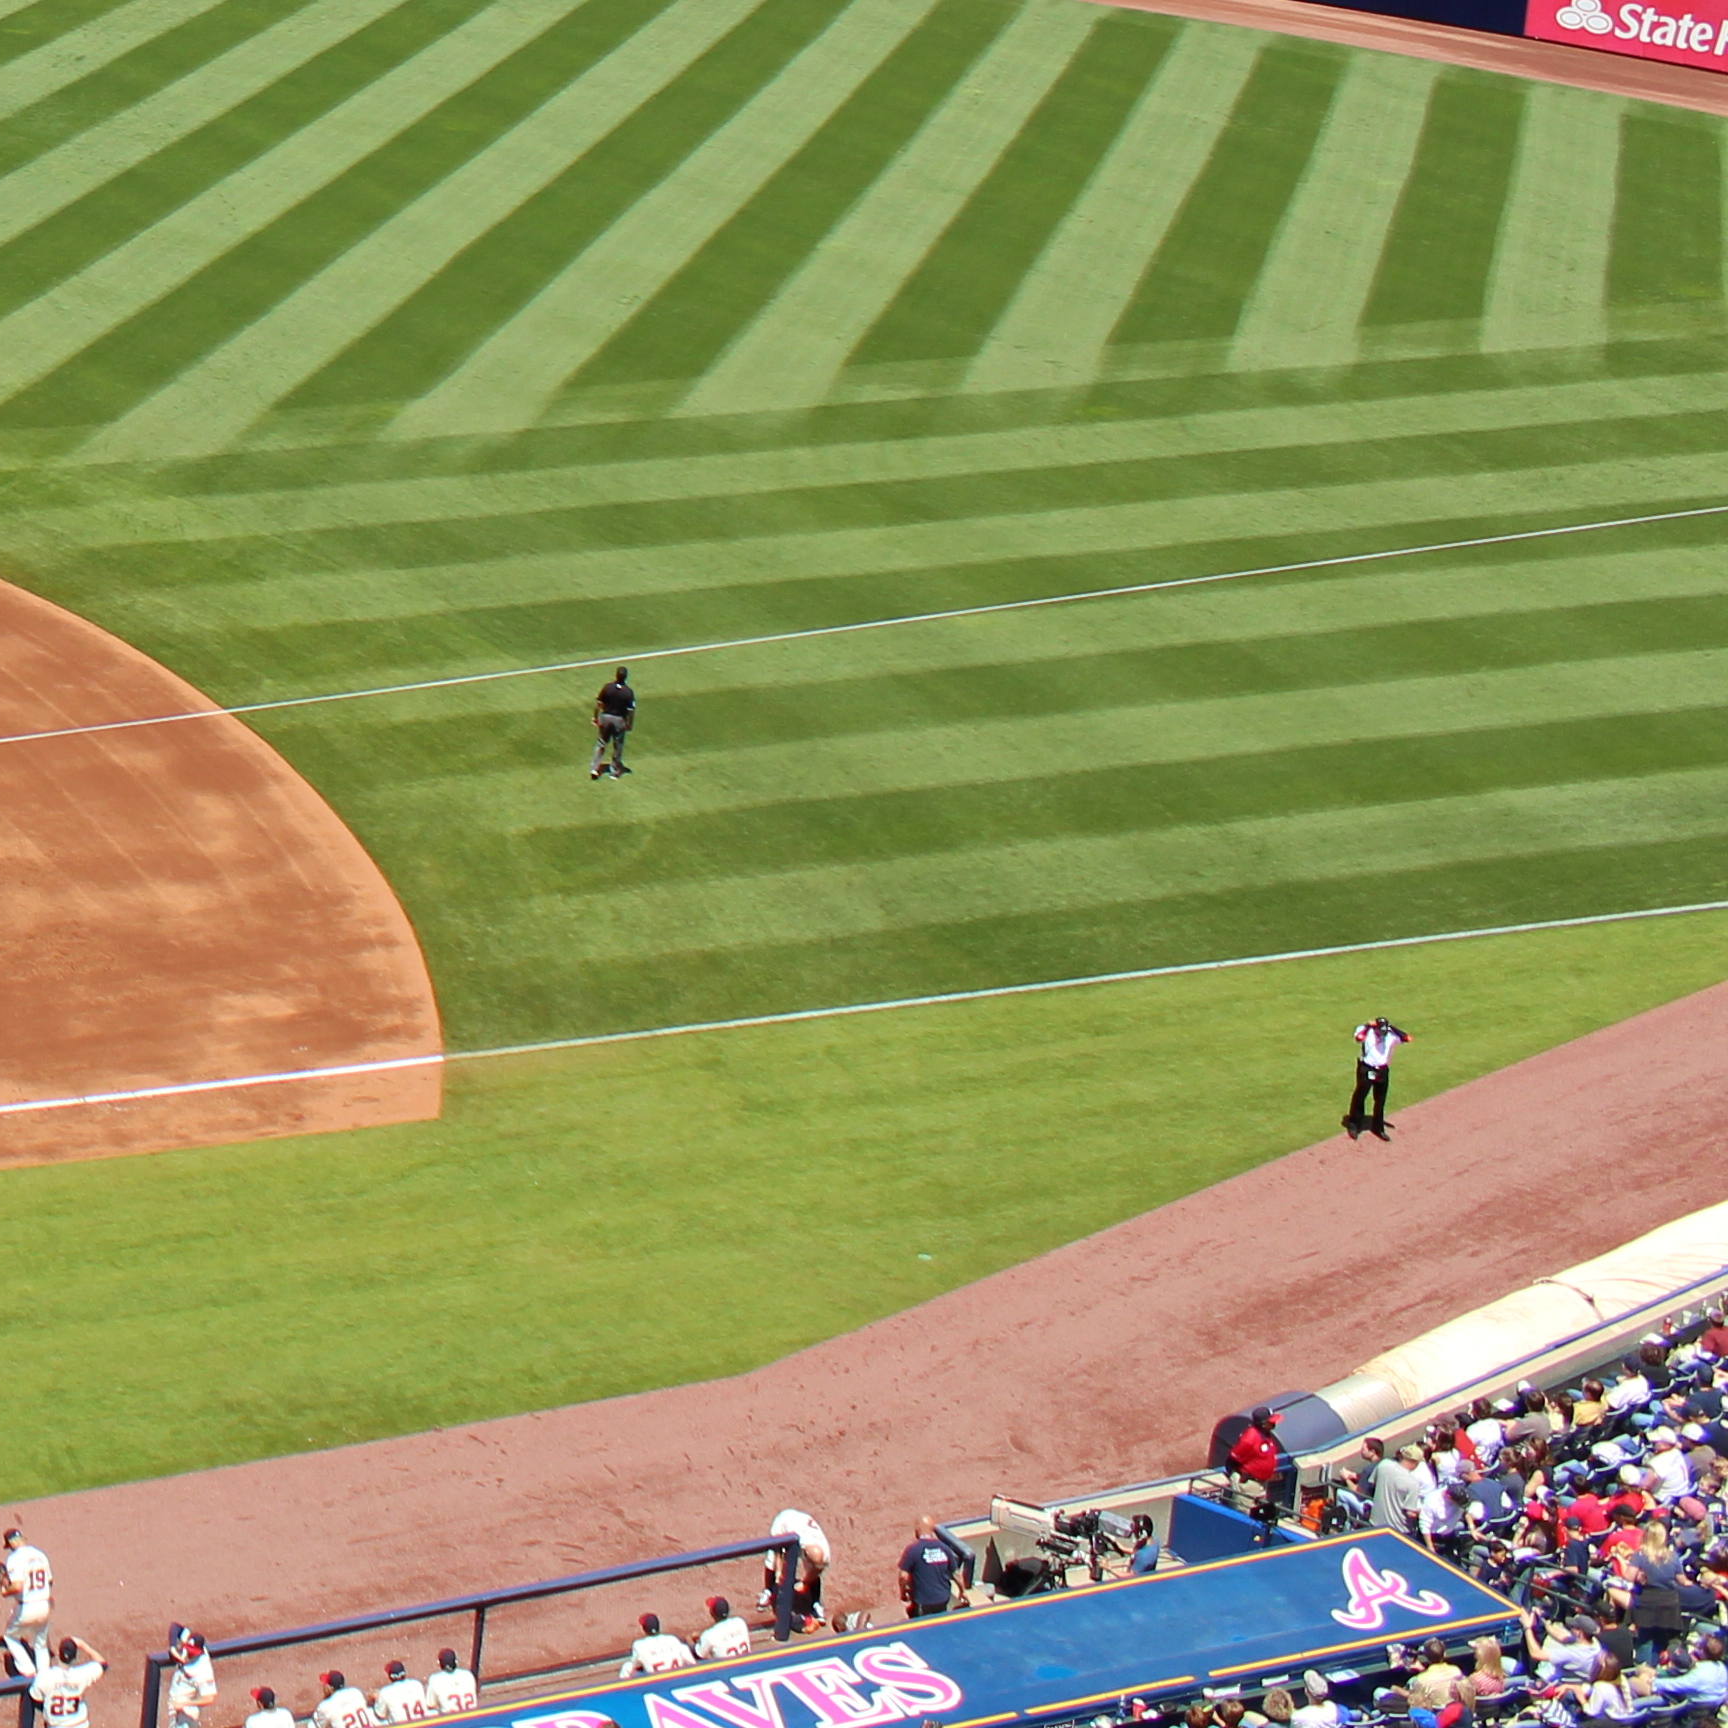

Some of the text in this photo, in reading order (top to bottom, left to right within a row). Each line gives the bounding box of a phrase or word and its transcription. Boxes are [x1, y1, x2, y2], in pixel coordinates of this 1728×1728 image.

[1613, 2, 1714, 53] State
[28, 1569, 46, 1591] 19
[50, 1695, 80, 1717] 23
